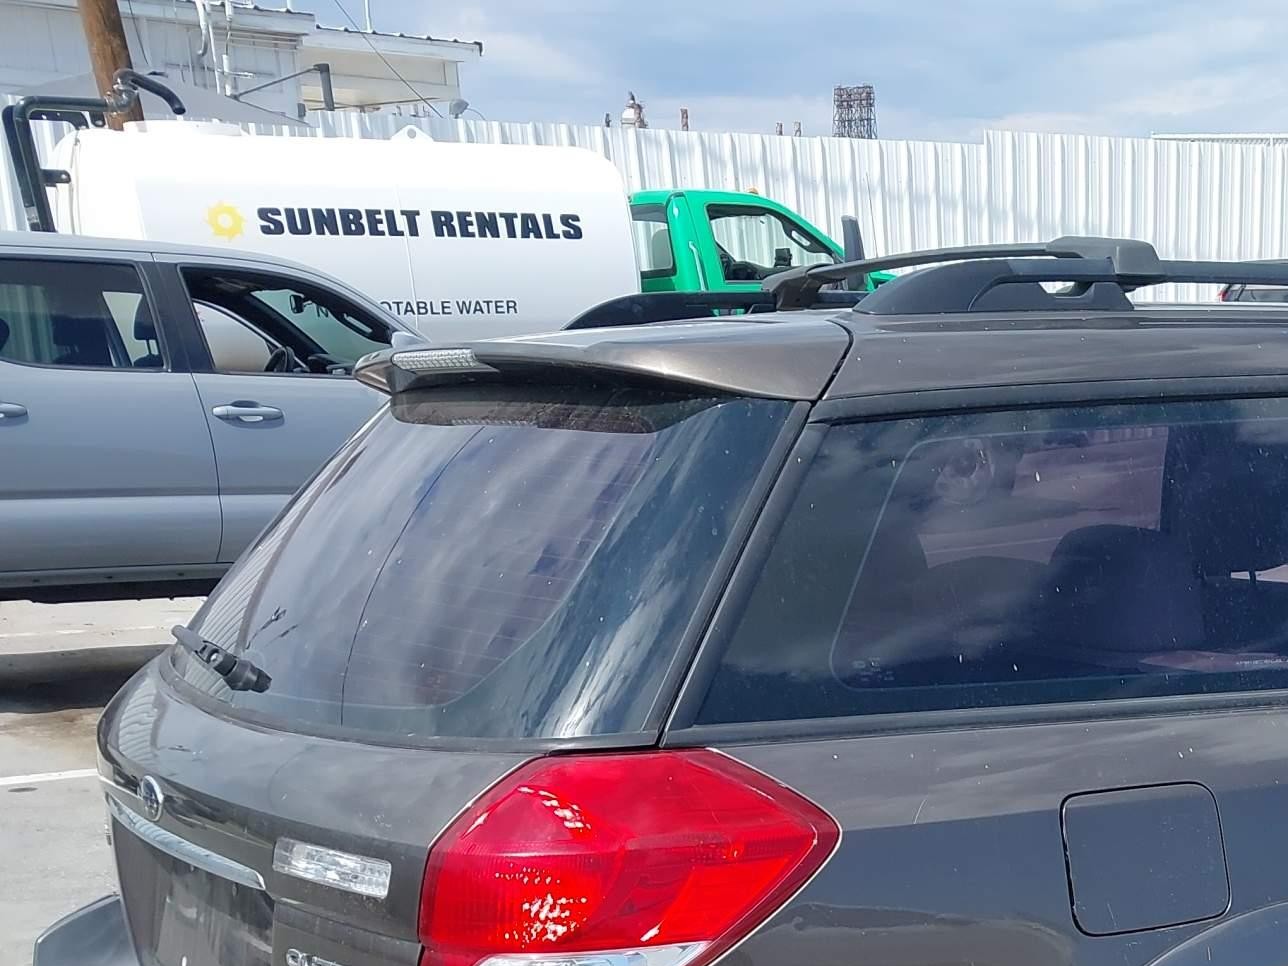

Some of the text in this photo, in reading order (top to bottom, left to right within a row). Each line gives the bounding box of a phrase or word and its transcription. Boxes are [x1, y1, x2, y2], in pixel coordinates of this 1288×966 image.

[257, 207, 583, 240] SUNBELT RENTALS
[455, 300, 518, 315] WATER
